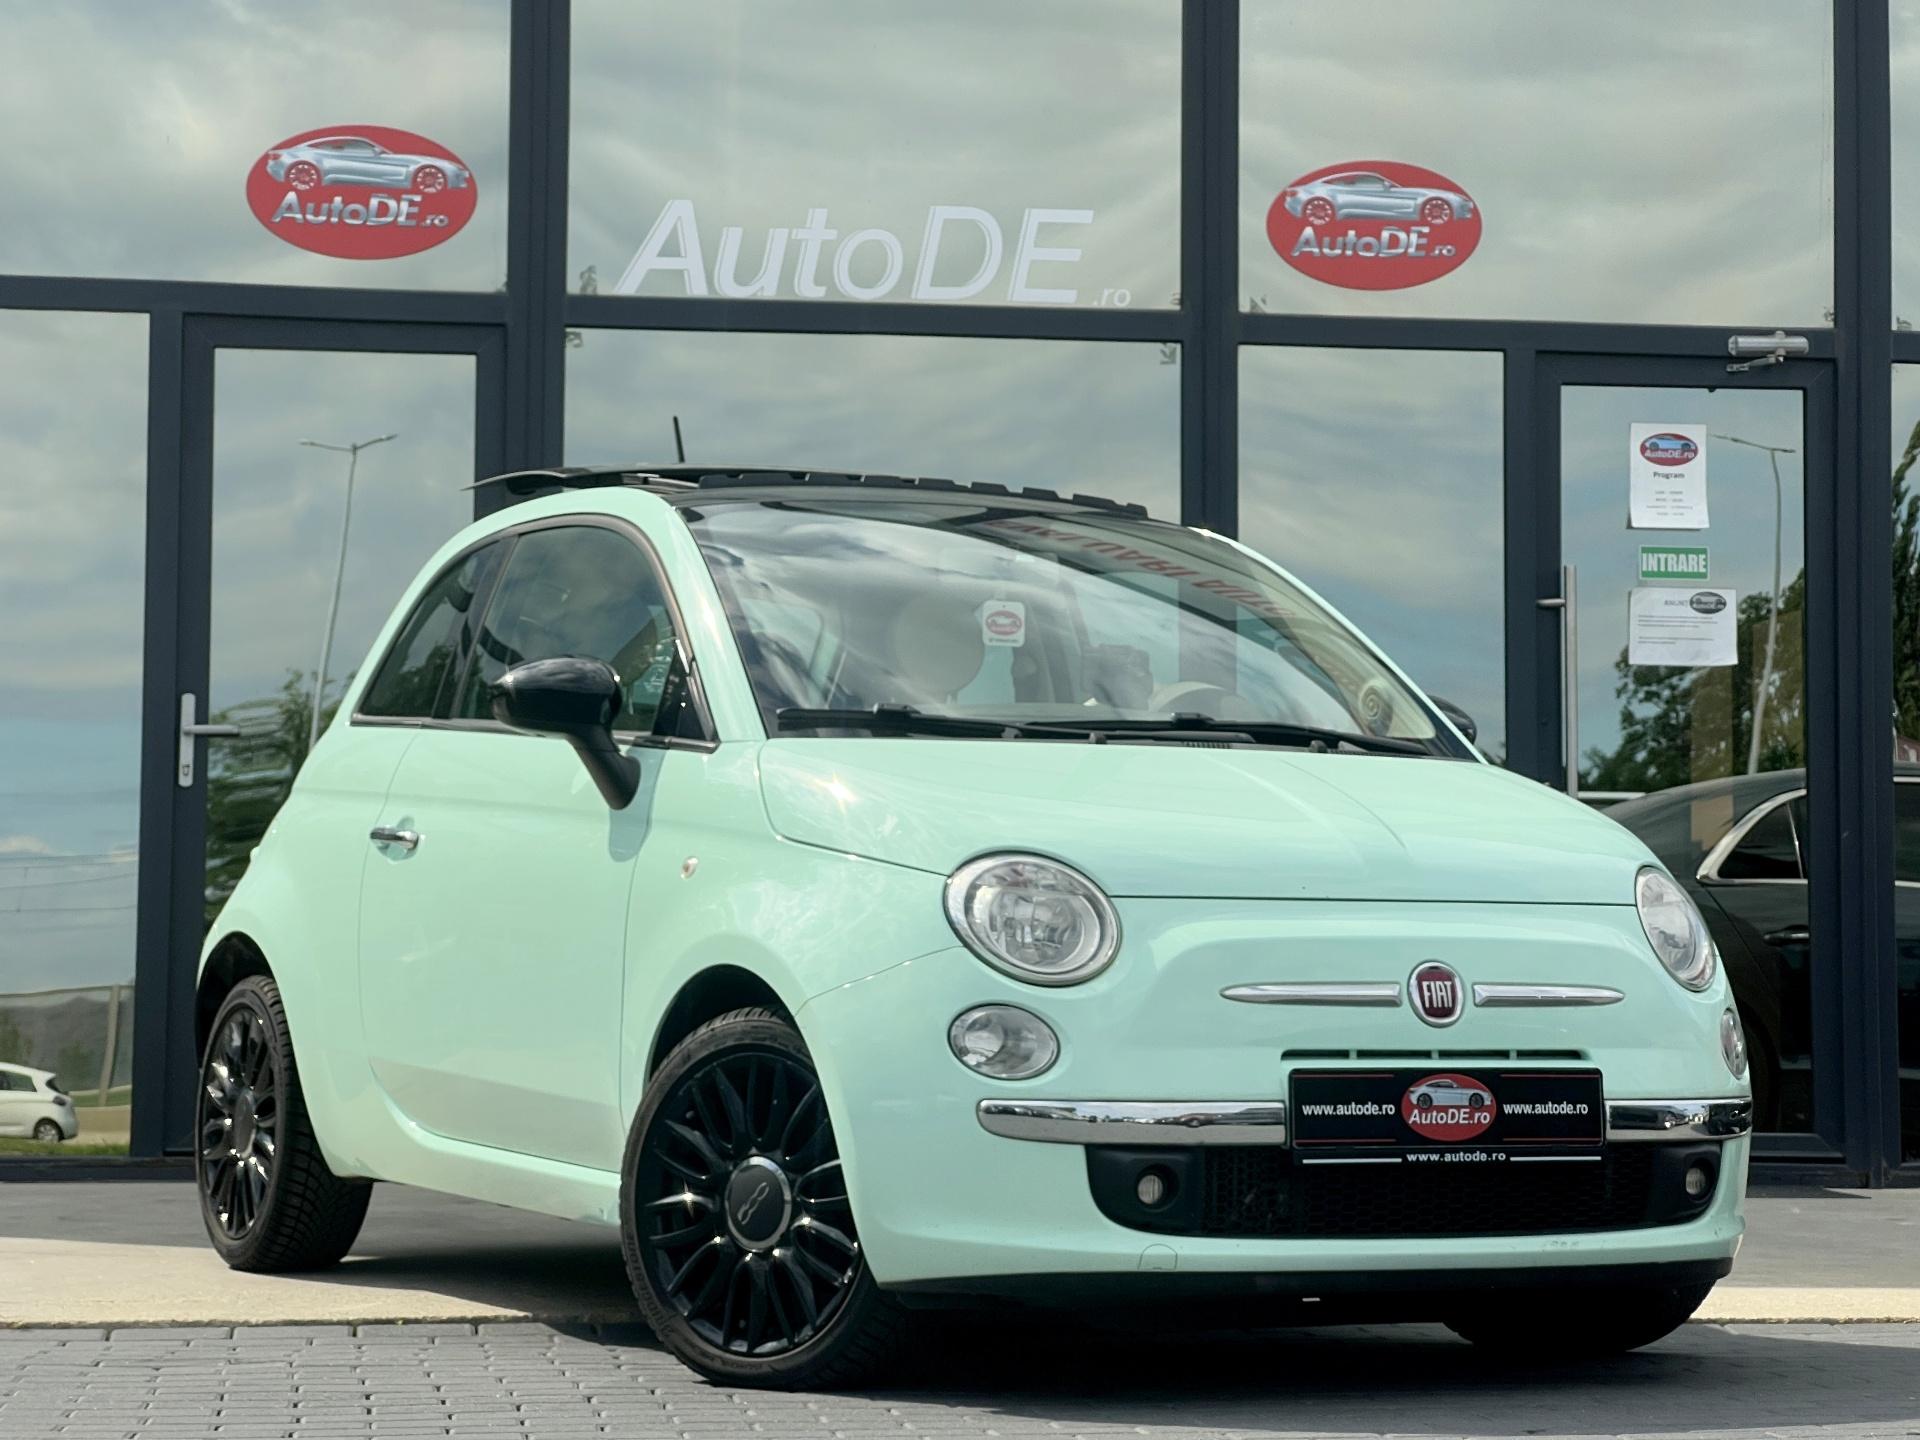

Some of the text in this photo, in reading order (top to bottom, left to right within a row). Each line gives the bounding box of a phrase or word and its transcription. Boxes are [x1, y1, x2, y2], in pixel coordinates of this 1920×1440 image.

[1653, 471, 1685, 480] Program
[1642, 552, 1706, 573] INTRARE
[1421, 980, 1452, 1009] FIAT
[1302, 1102, 1396, 1116] www.autode.ro
[1503, 1101, 1589, 1115] www.autode.ro
[1408, 1108, 1491, 1125] AutoDE.ro
[1406, 1150, 1506, 1163] www.autode.ro
